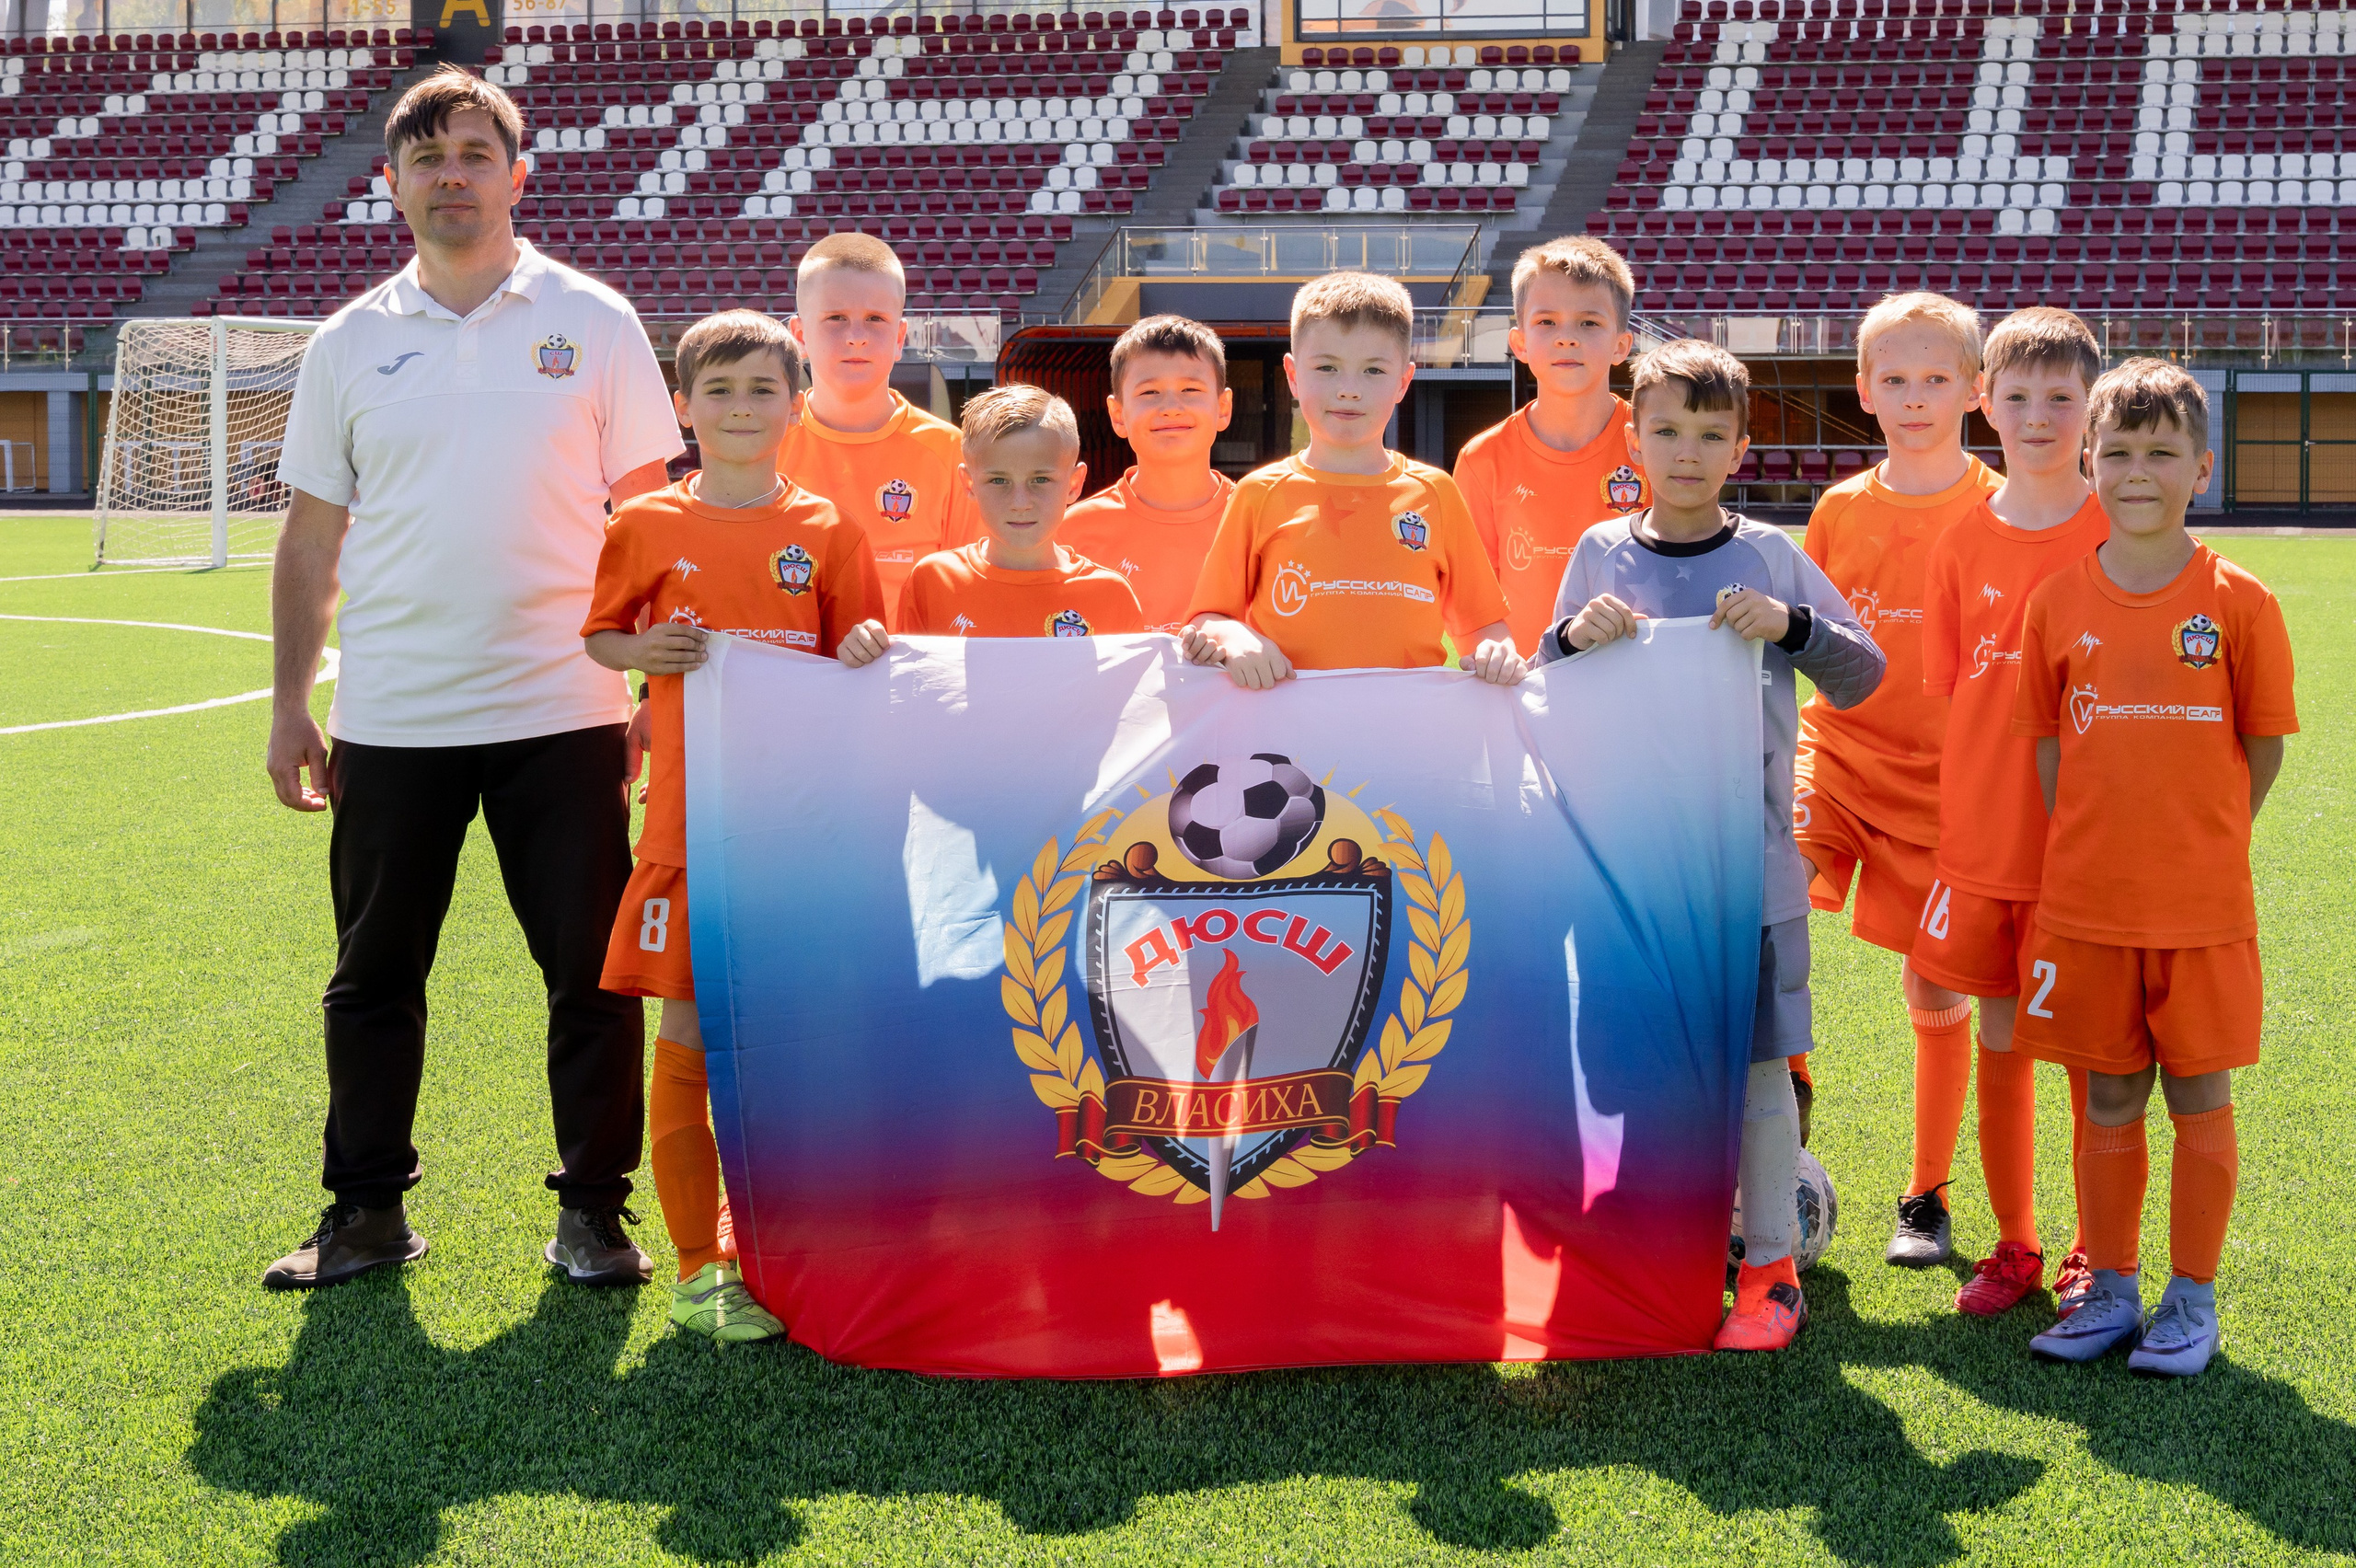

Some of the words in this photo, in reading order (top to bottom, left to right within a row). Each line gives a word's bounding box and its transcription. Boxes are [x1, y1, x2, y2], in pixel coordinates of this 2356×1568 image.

[1612, 483, 1637, 492] ДЮСШ
[782, 563, 809, 574] ДЮСШ
[1310, 580, 1403, 592] РУССКИЙ
[1405, 585, 1434, 601] САПР
[1310, 590, 1345, 598] ГРУППА
[2186, 634, 2214, 645] ДЮСШ
[2096, 704, 2186, 715] РУССКИЙ
[1919, 878, 1951, 940] 16
[639, 897, 671, 953] 8
[1122, 907, 1356, 989] ДЮСШ
[2027, 959, 2057, 1019] 2
[1130, 1083, 1323, 1127] ВЛАСИХА
